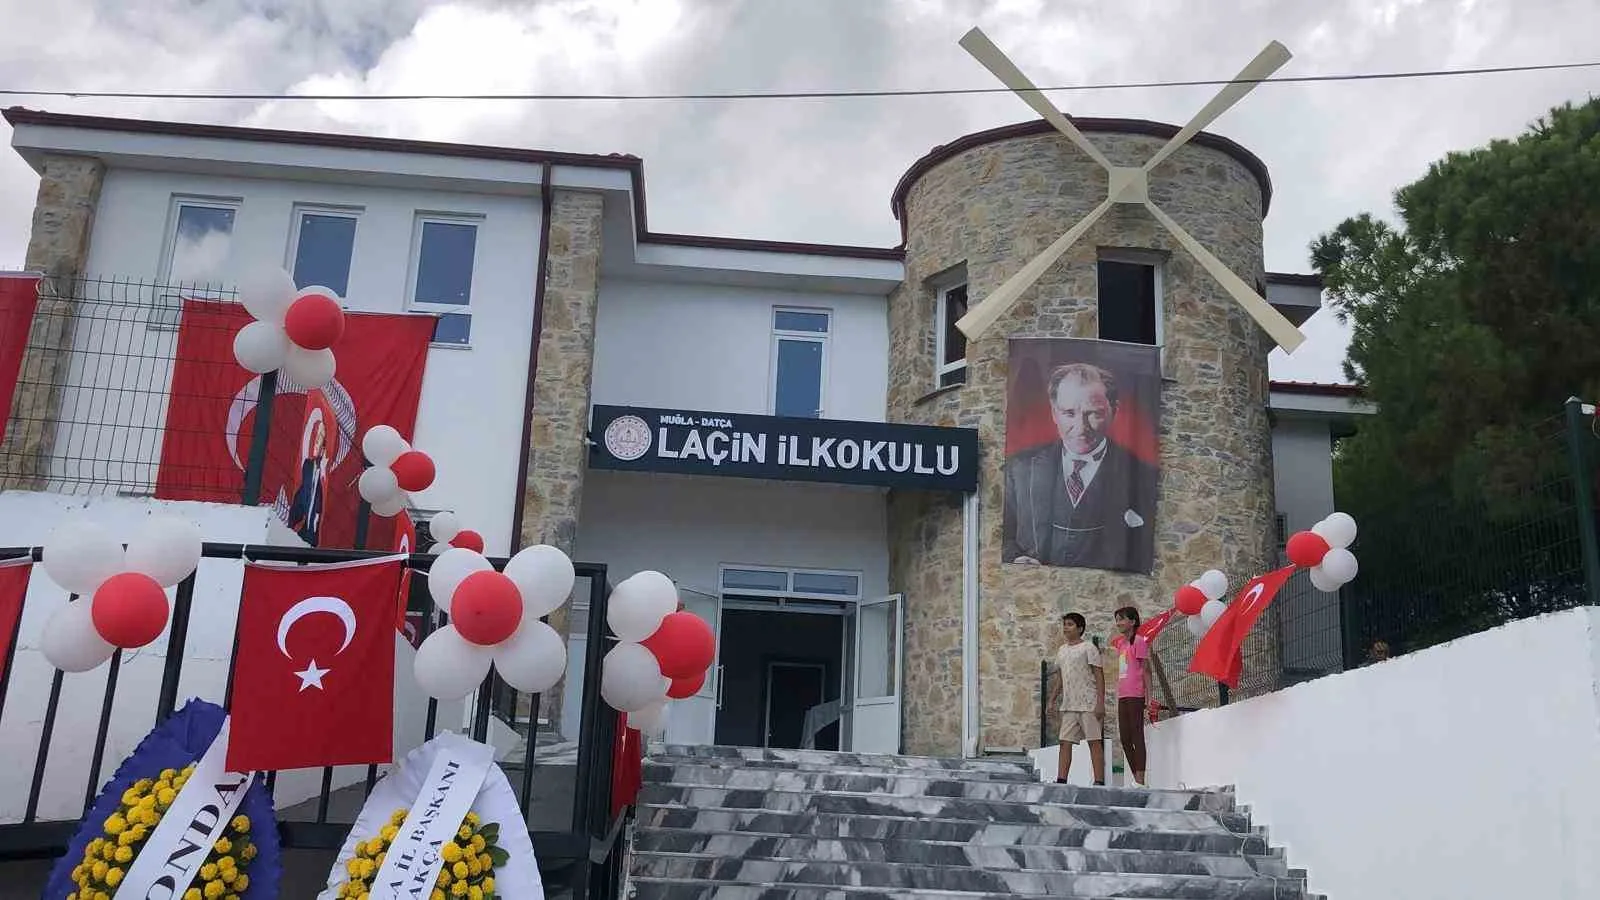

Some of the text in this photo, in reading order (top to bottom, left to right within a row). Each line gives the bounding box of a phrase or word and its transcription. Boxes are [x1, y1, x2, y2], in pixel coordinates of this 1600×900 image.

[660, 413, 694, 426] MUĞLA
[701, 417, 733, 429] DATÇA
[146, 776, 248, 900] ONDA
[410, 759, 461, 843] BAŞKANI
